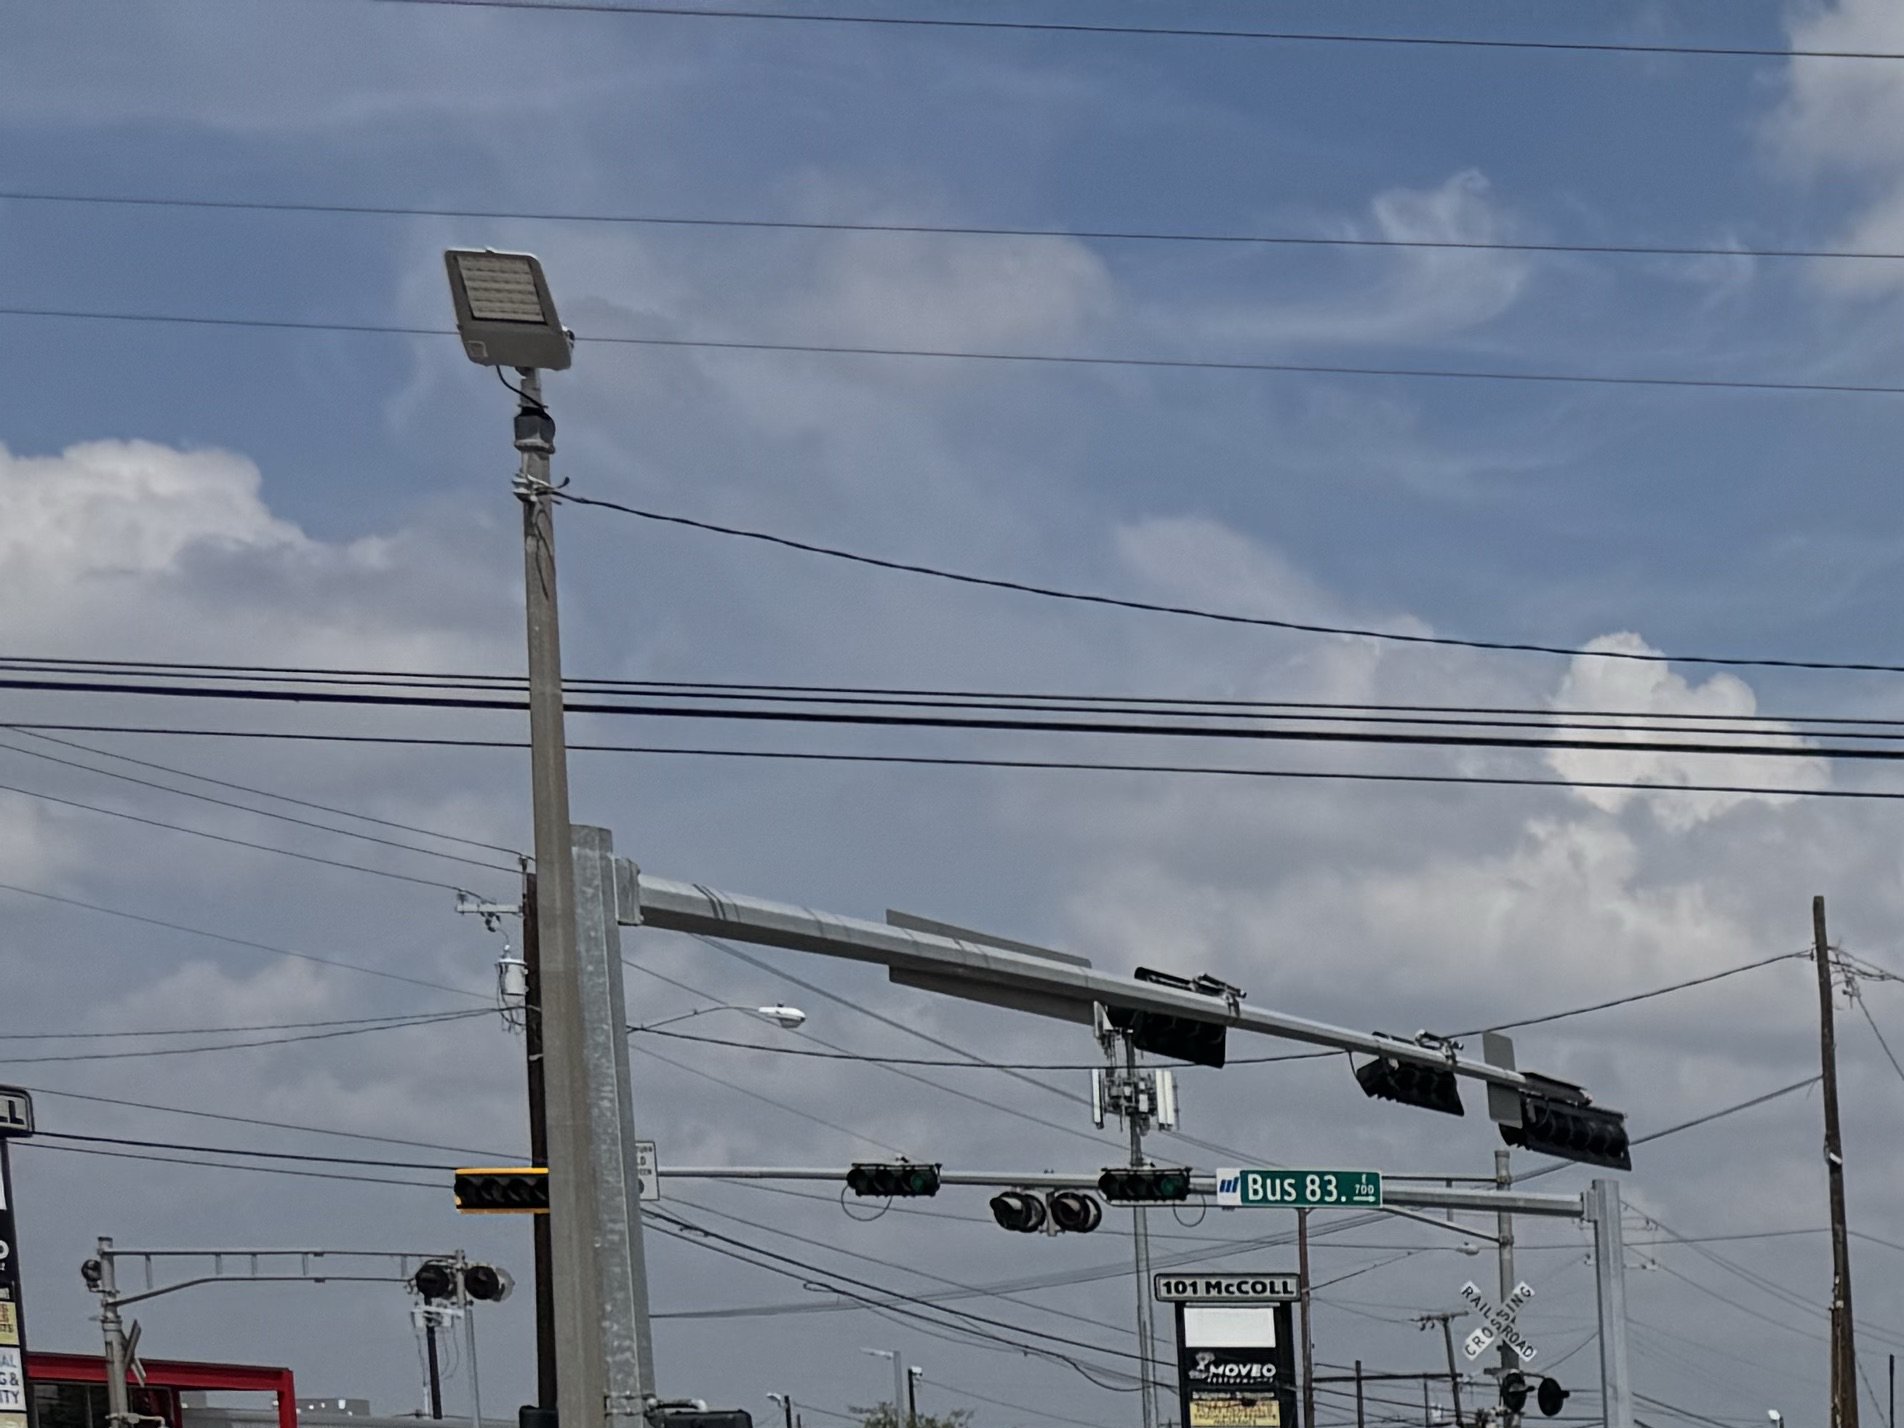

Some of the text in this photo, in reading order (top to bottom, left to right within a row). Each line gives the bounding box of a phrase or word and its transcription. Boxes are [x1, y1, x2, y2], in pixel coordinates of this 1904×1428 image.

[1247, 1173, 1297, 1202] Bus
[1354, 1184, 1375, 1195] 700
[1162, 1280, 1295, 1296] 101 McCOLL
[1461, 1286, 1534, 1357] RAILROAD
[1464, 1286, 1531, 1357] CROSSING
[1209, 1363, 1276, 1377] MOVEO
